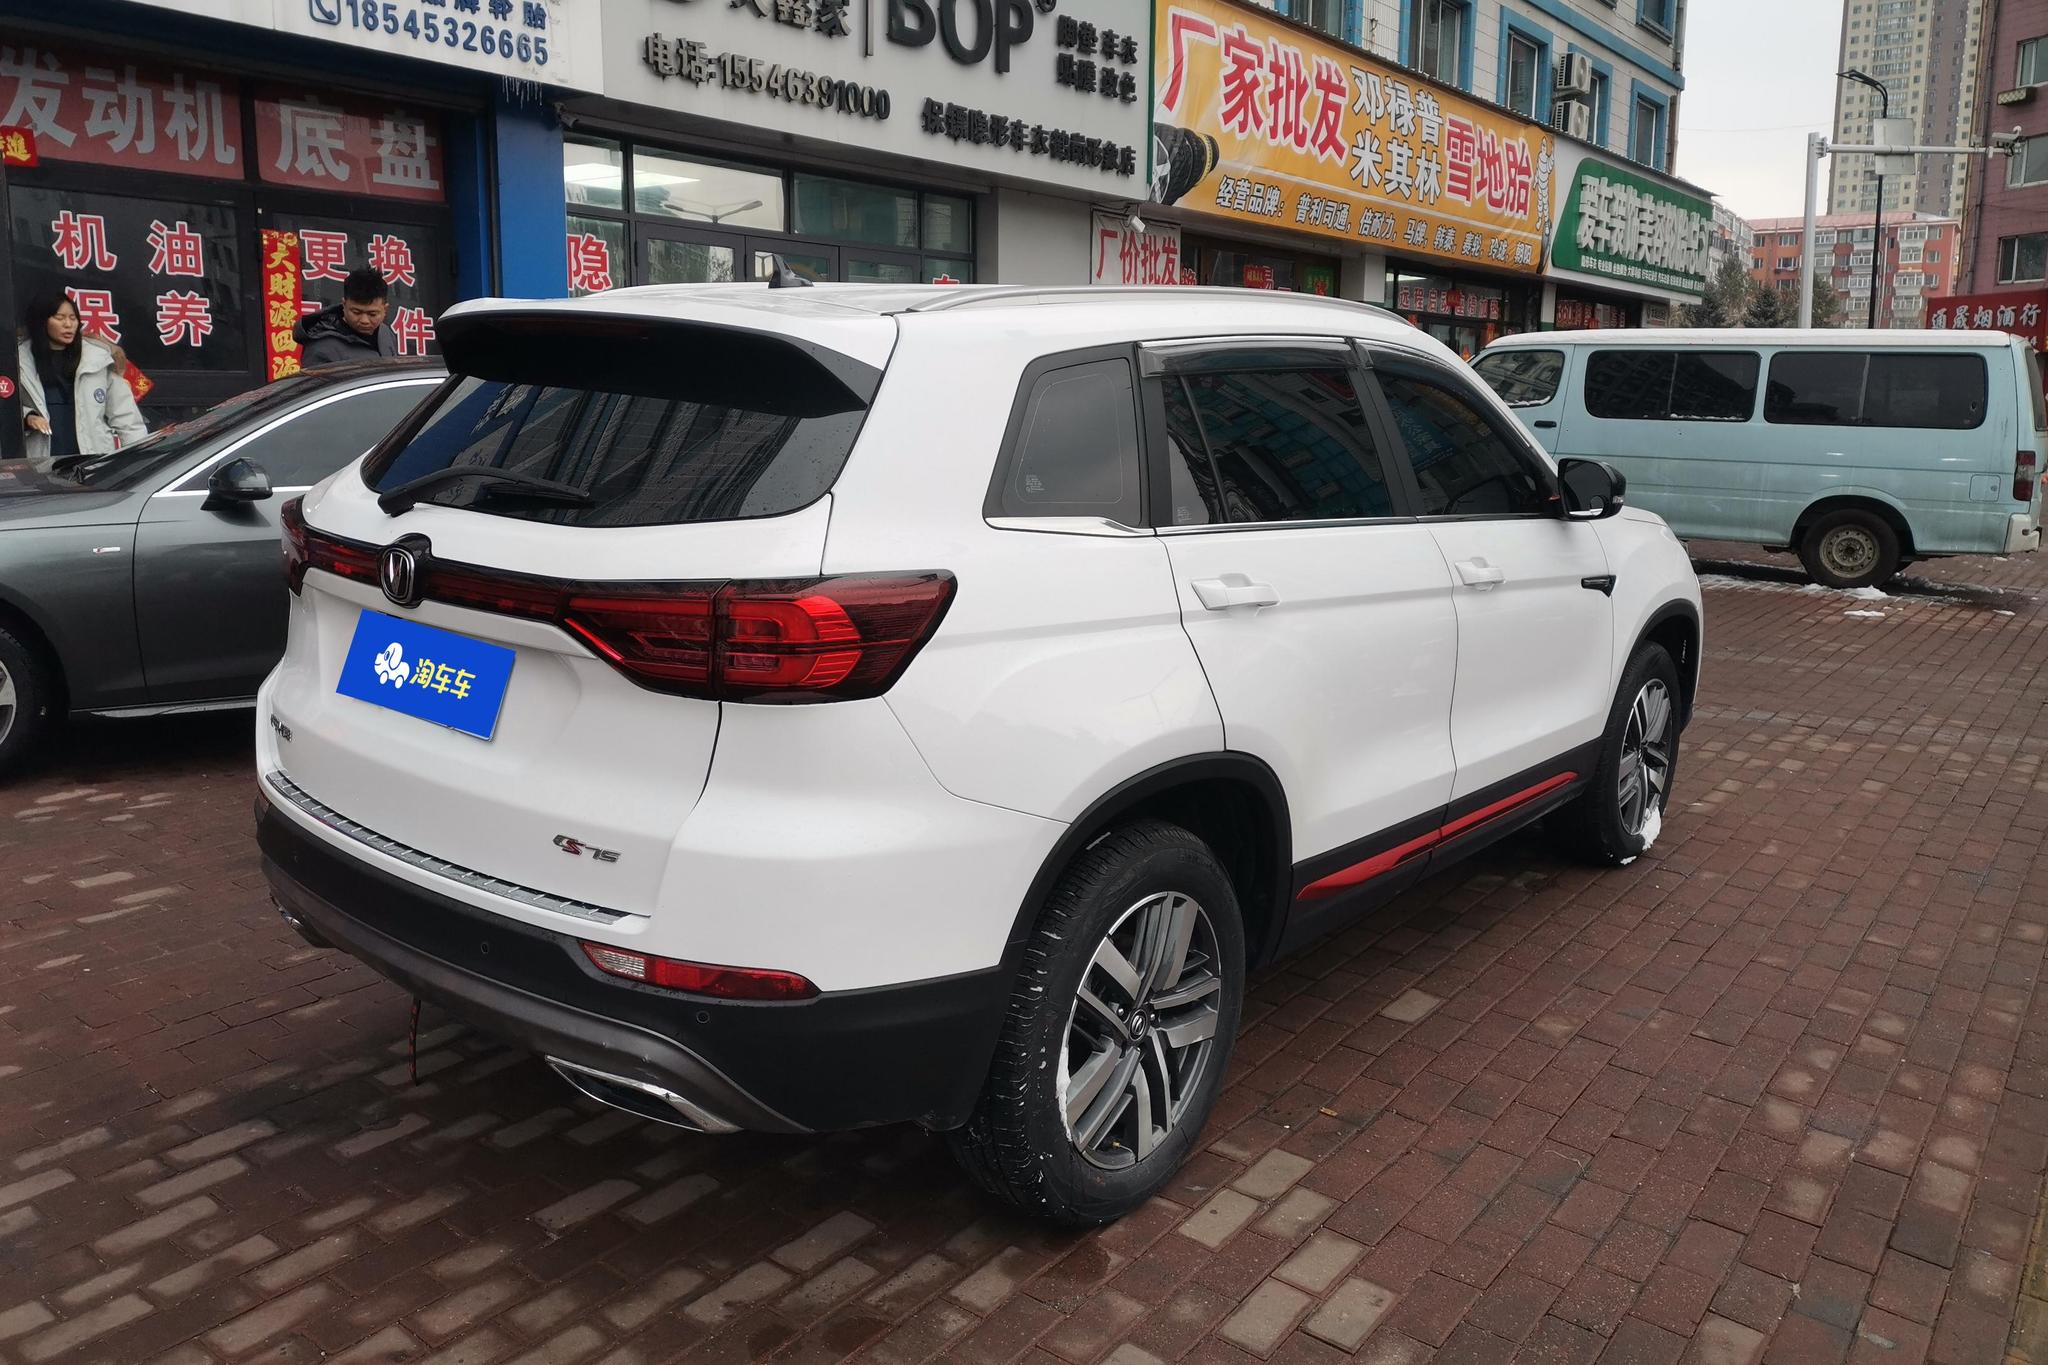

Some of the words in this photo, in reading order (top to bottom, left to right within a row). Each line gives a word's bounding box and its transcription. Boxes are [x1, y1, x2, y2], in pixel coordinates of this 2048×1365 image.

[346, 0, 549, 66] 18545326665
[0, 48, 235, 164] 发动机
[1161, 10, 1349, 164] 厂家批发
[1350, 65, 1444, 147] 邓禄普
[275, 95, 440, 189] 底盘
[1350, 128, 1443, 205] 米其林
[1446, 113, 1534, 219] 雪地胎
[52, 210, 205, 277] 机油
[300, 229, 416, 287] 更换
[1096, 228, 1178, 285] 厂价批发
[65, 286, 213, 346] 保养
